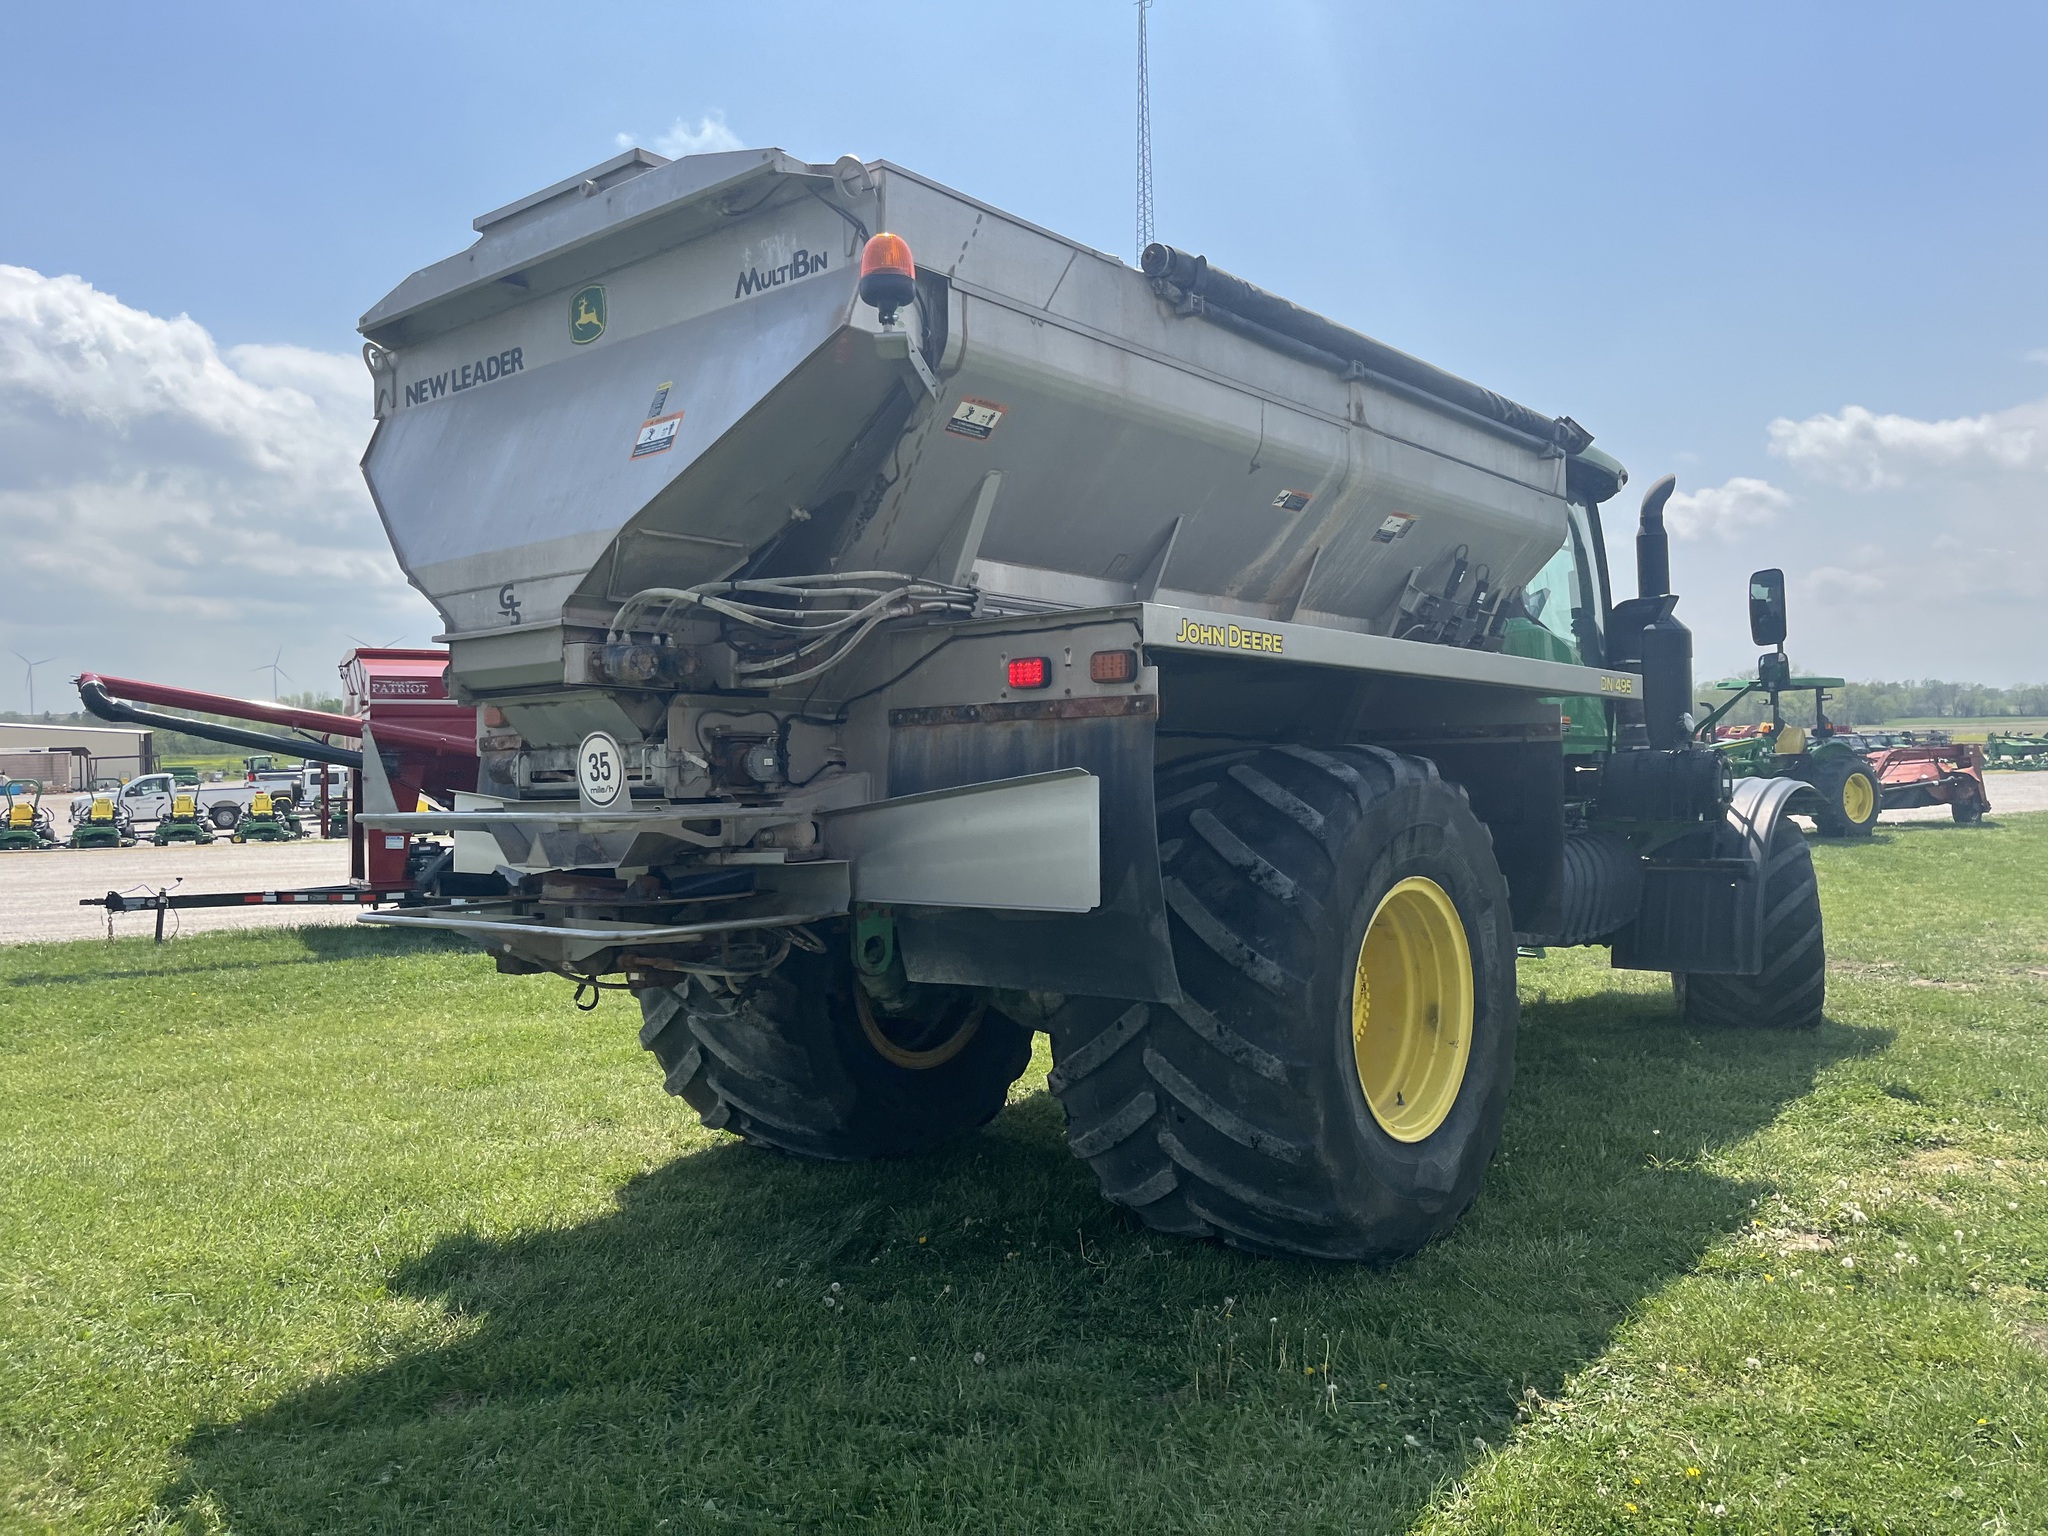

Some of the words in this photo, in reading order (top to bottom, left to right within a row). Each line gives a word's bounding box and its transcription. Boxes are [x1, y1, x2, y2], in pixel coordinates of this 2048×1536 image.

[405, 372, 449, 407] NEW
[451, 347, 524, 393] LEADER
[1176, 617, 1225, 647] JOHN
[1227, 623, 1284, 654] DEERE
[371, 683, 429, 694] PATRIOT
[1601, 675, 1613, 692] DN
[1615, 677, 1632, 694] 495
[588, 751, 611, 782] 35
[590, 785, 614, 794] mile/h
